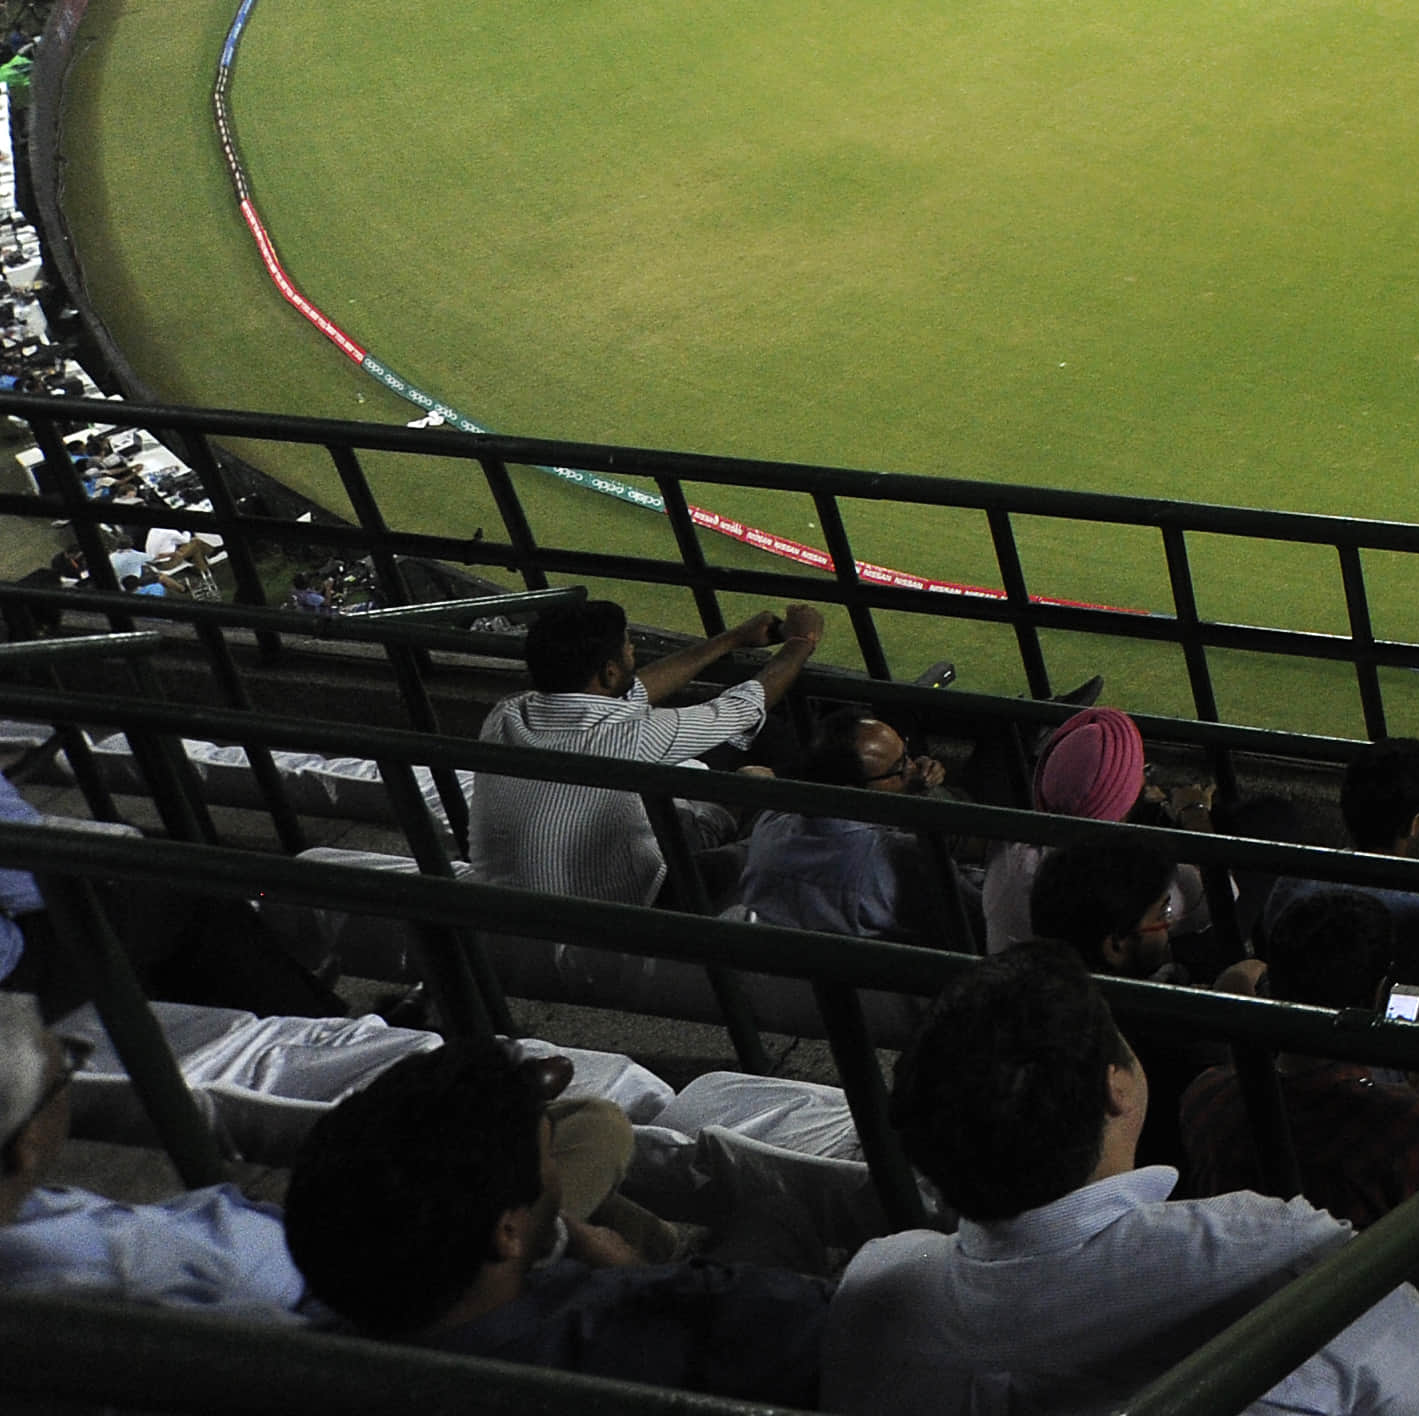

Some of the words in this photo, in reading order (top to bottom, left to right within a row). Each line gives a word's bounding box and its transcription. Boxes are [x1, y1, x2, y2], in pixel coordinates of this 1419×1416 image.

[408, 389, 432, 406] oppo
[592, 478, 624, 495] oppo
[628, 490, 662, 507] oppo
